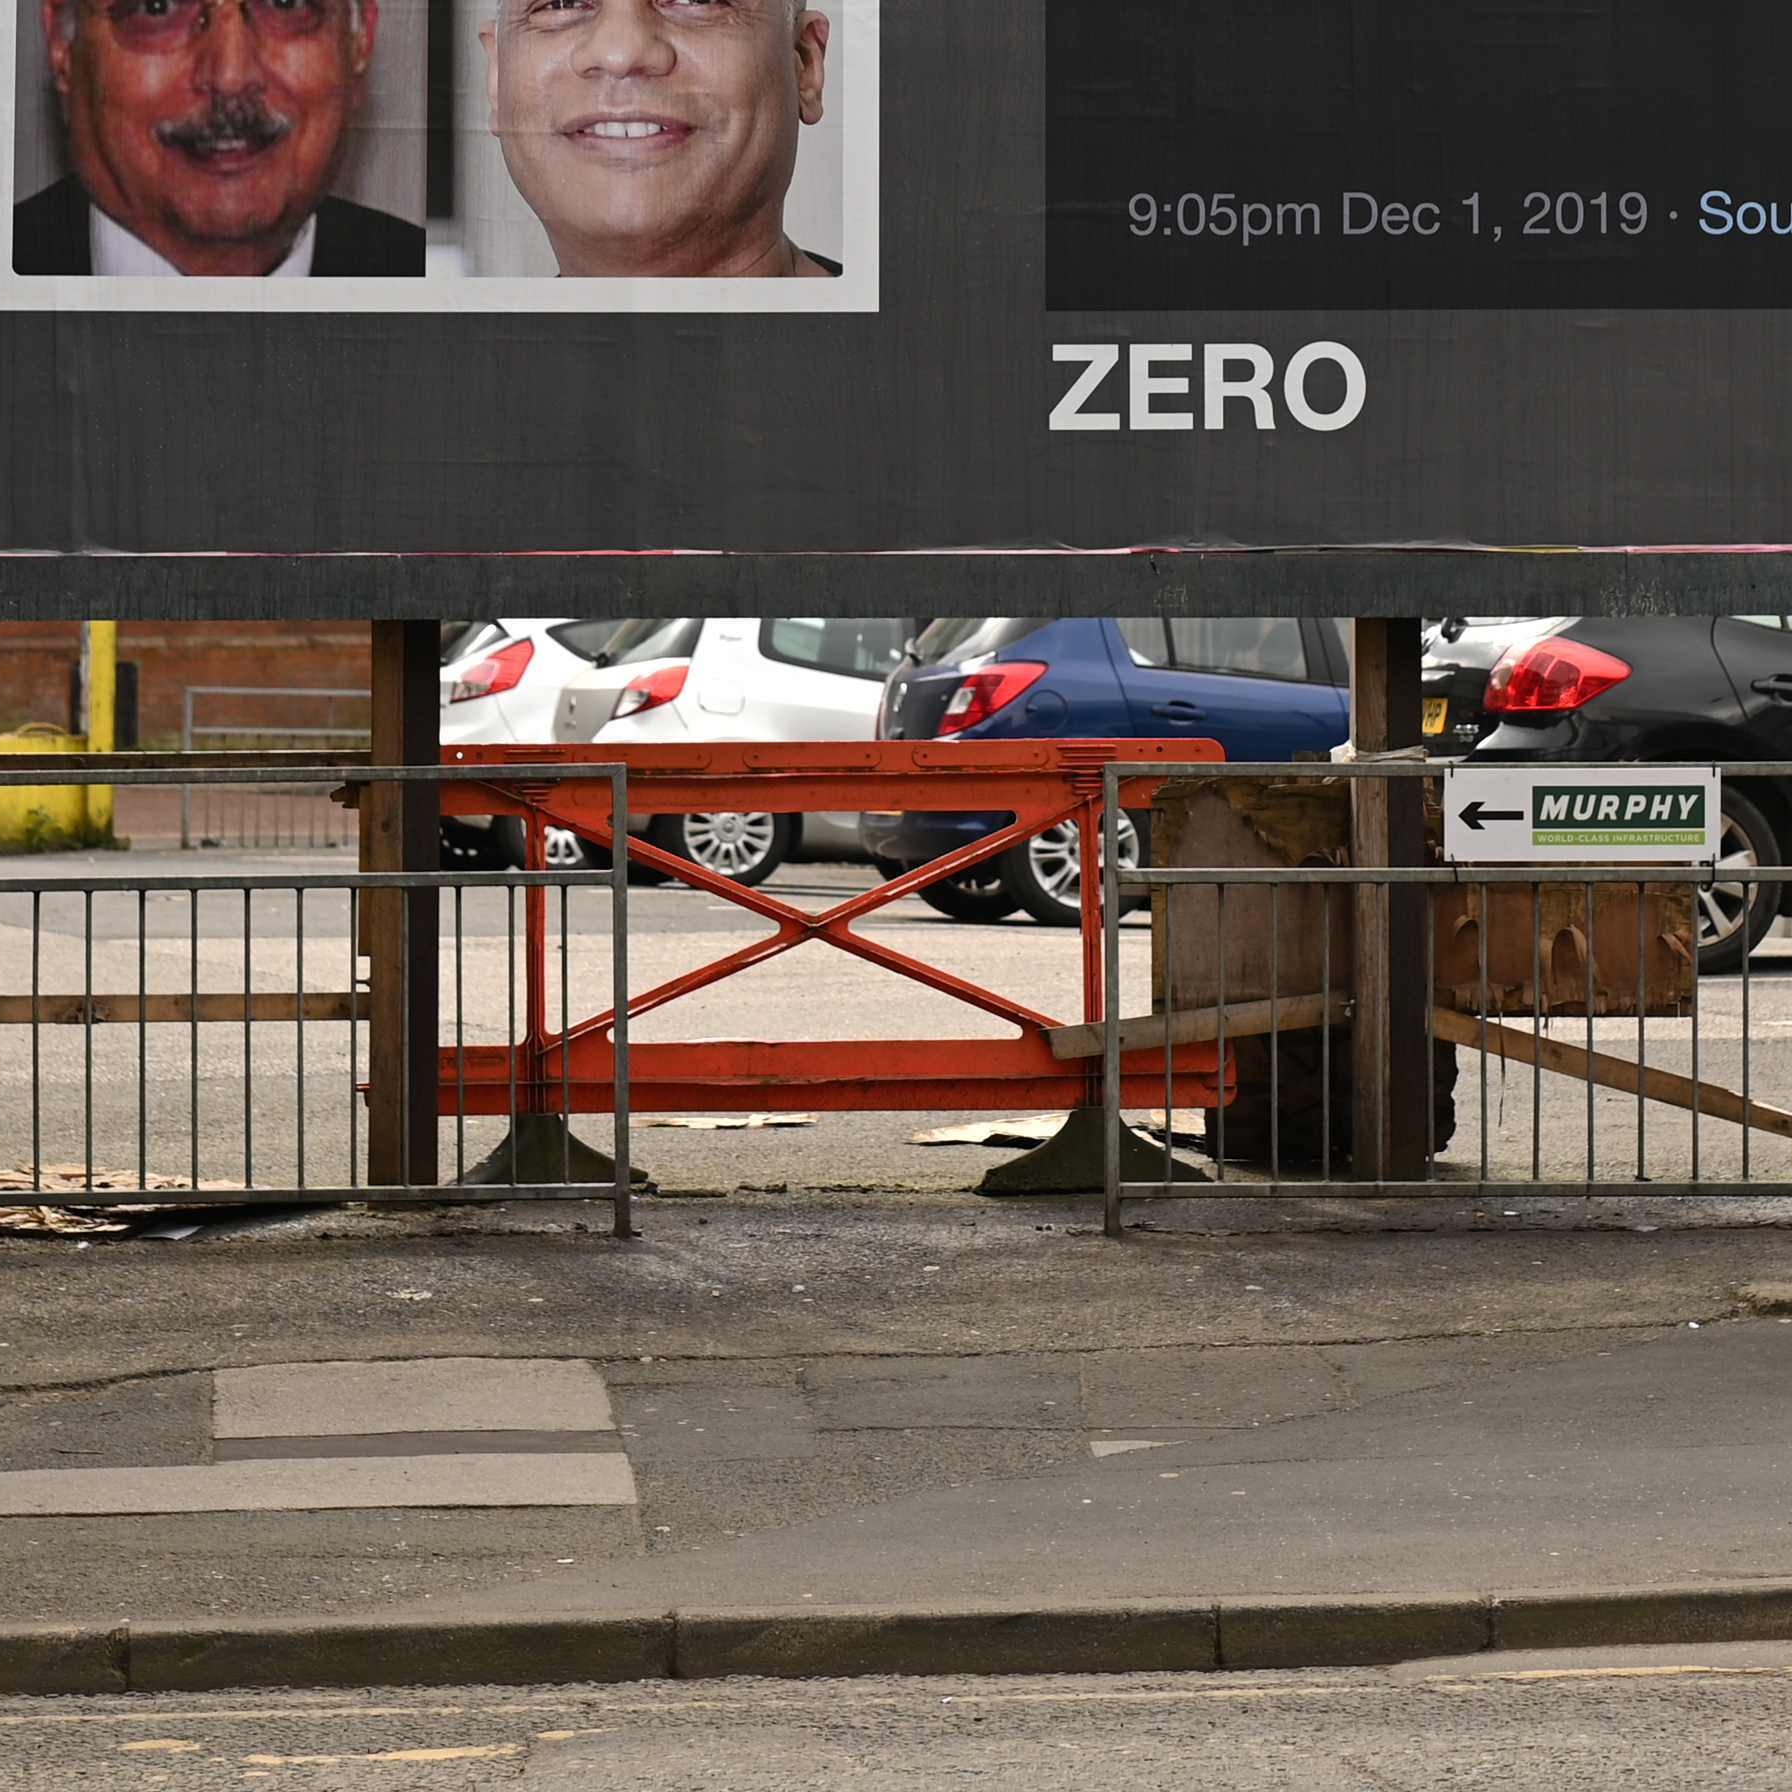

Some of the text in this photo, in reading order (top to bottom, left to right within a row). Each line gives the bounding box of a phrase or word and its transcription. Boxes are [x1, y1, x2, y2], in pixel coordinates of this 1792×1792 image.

[1128, 193, 1320, 246] 9:05pm
[1343, 192, 1440, 235] Dec
[1461, 192, 1502, 242] 1,
[1523, 191, 1649, 235] 2019
[1049, 341, 1368, 432] ZERO
[1539, 794, 1699, 821] MURPHY
[1537, 833, 1700, 843] WORLD-CLASS INFRASTRUCTURE
